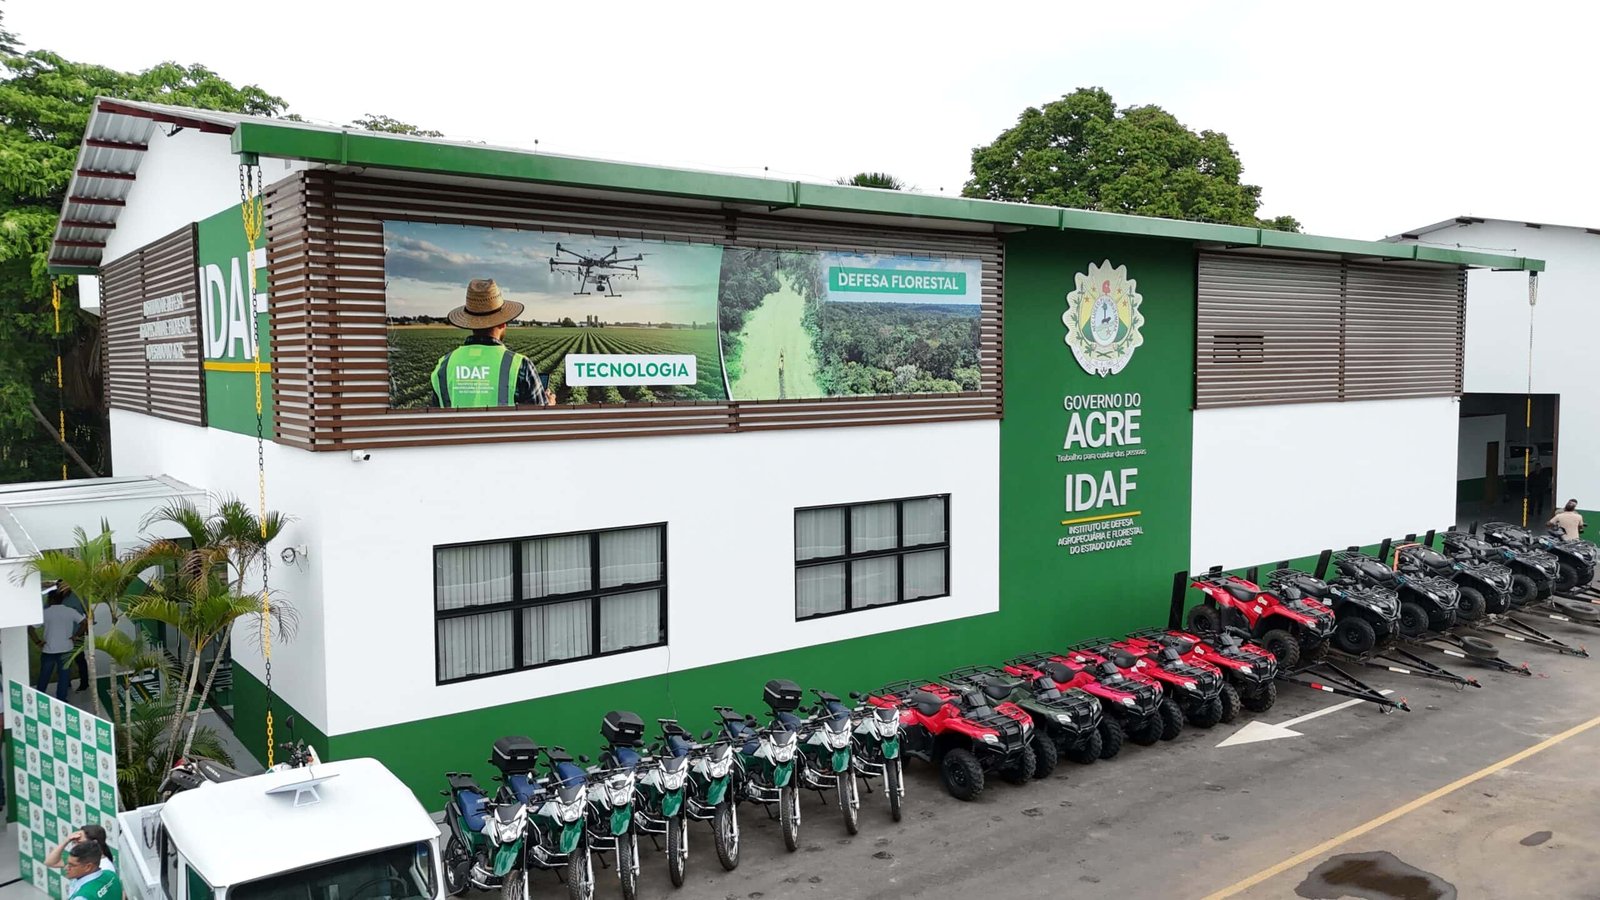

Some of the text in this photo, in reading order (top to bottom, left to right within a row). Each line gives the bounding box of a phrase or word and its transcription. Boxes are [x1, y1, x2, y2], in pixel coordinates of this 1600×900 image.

[838, 273, 959, 290] DEFESA FLORESTAL
[199, 247, 268, 359] IDAF
[456, 365, 490, 380] IDAF
[574, 362, 689, 378] TECNOLOGIA
[1064, 393, 1141, 410] GOVERNO DO
[1064, 409, 1141, 449] ACRE
[1066, 468, 1138, 512] IDAF
[1069, 518, 1134, 534] INSTITUTO DE DEFESA
[1112, 527, 1143, 537] FLORESTAL
[1070, 538, 1132, 554] DO ESTADO DO ACRE
